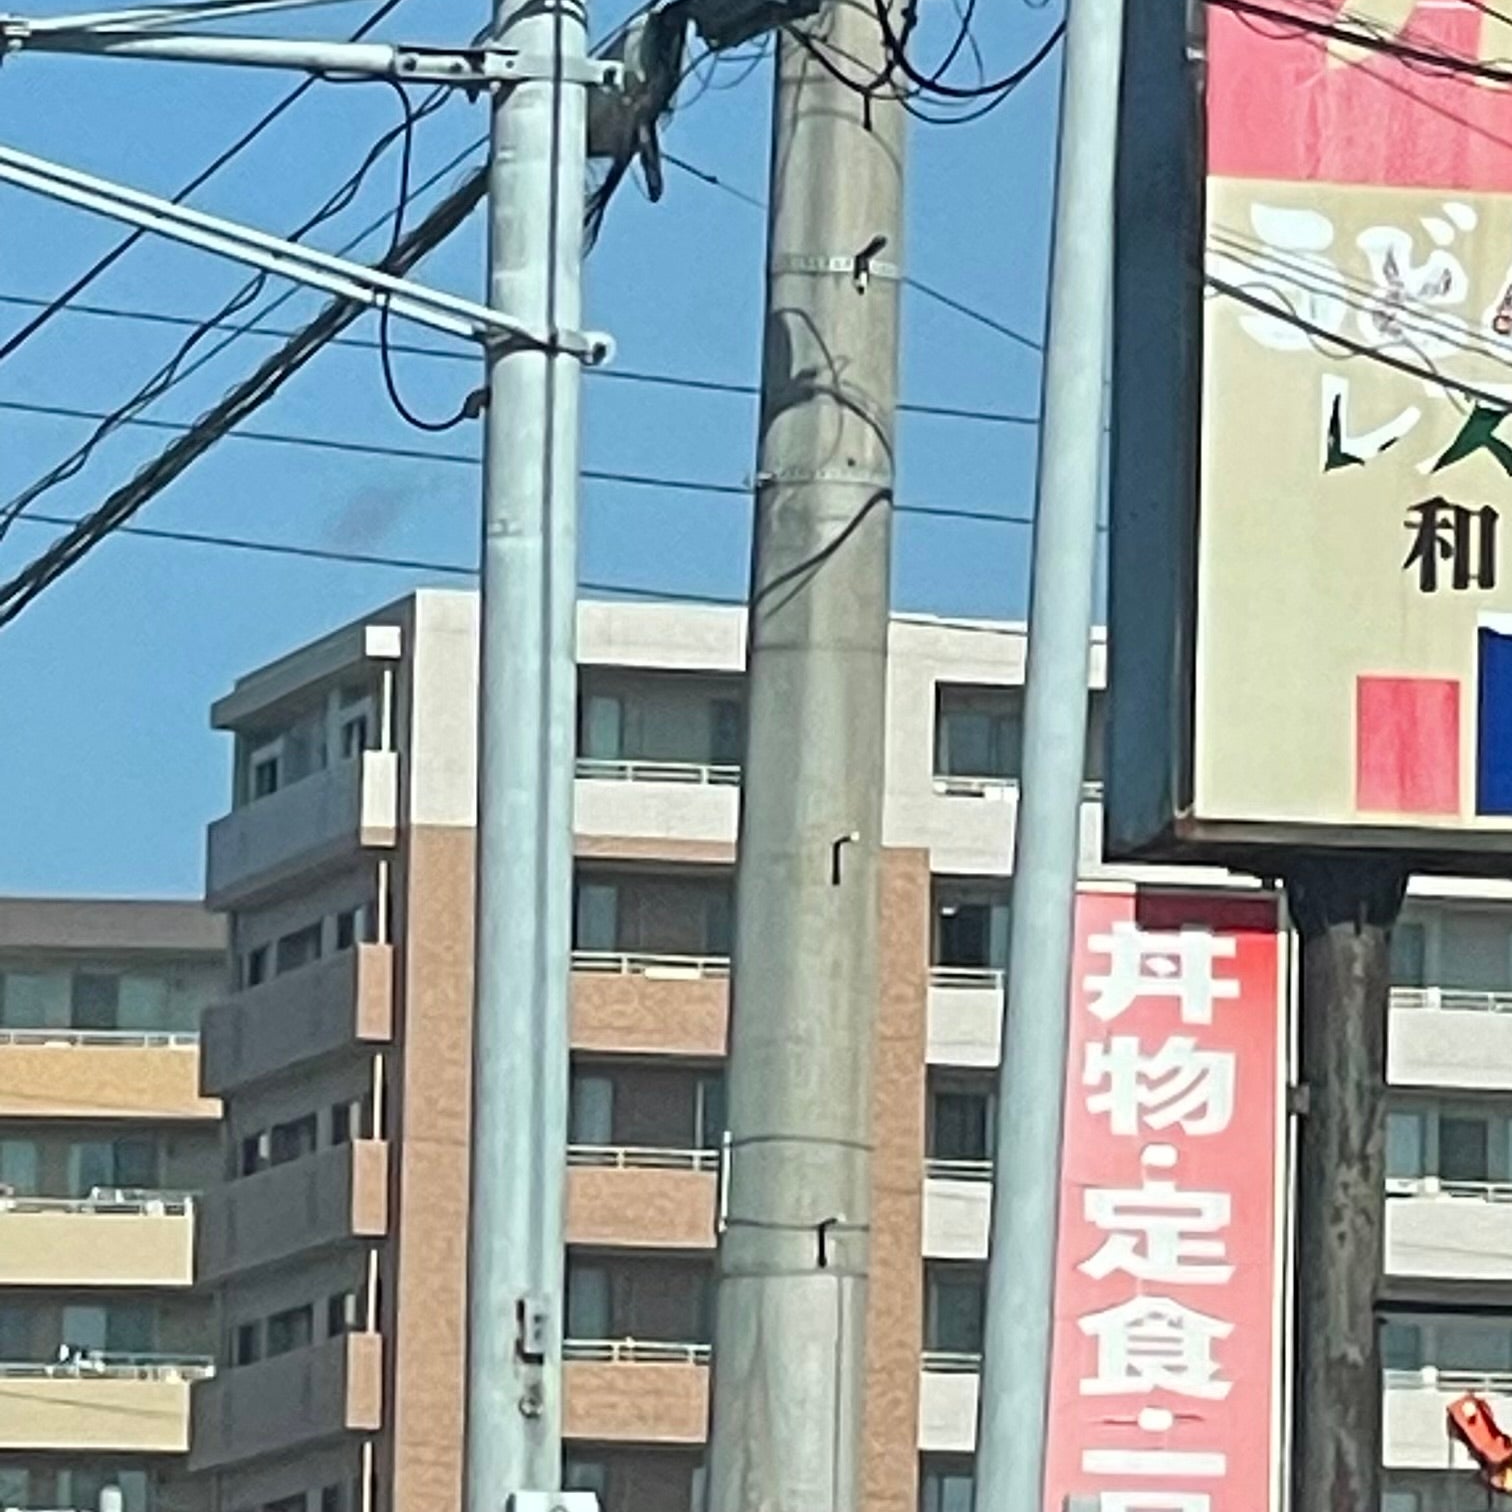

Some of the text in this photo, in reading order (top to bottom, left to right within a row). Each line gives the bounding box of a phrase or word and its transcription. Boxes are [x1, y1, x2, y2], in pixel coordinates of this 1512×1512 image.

[1076, 920, 1241, 1512] 丼物・定食・一
